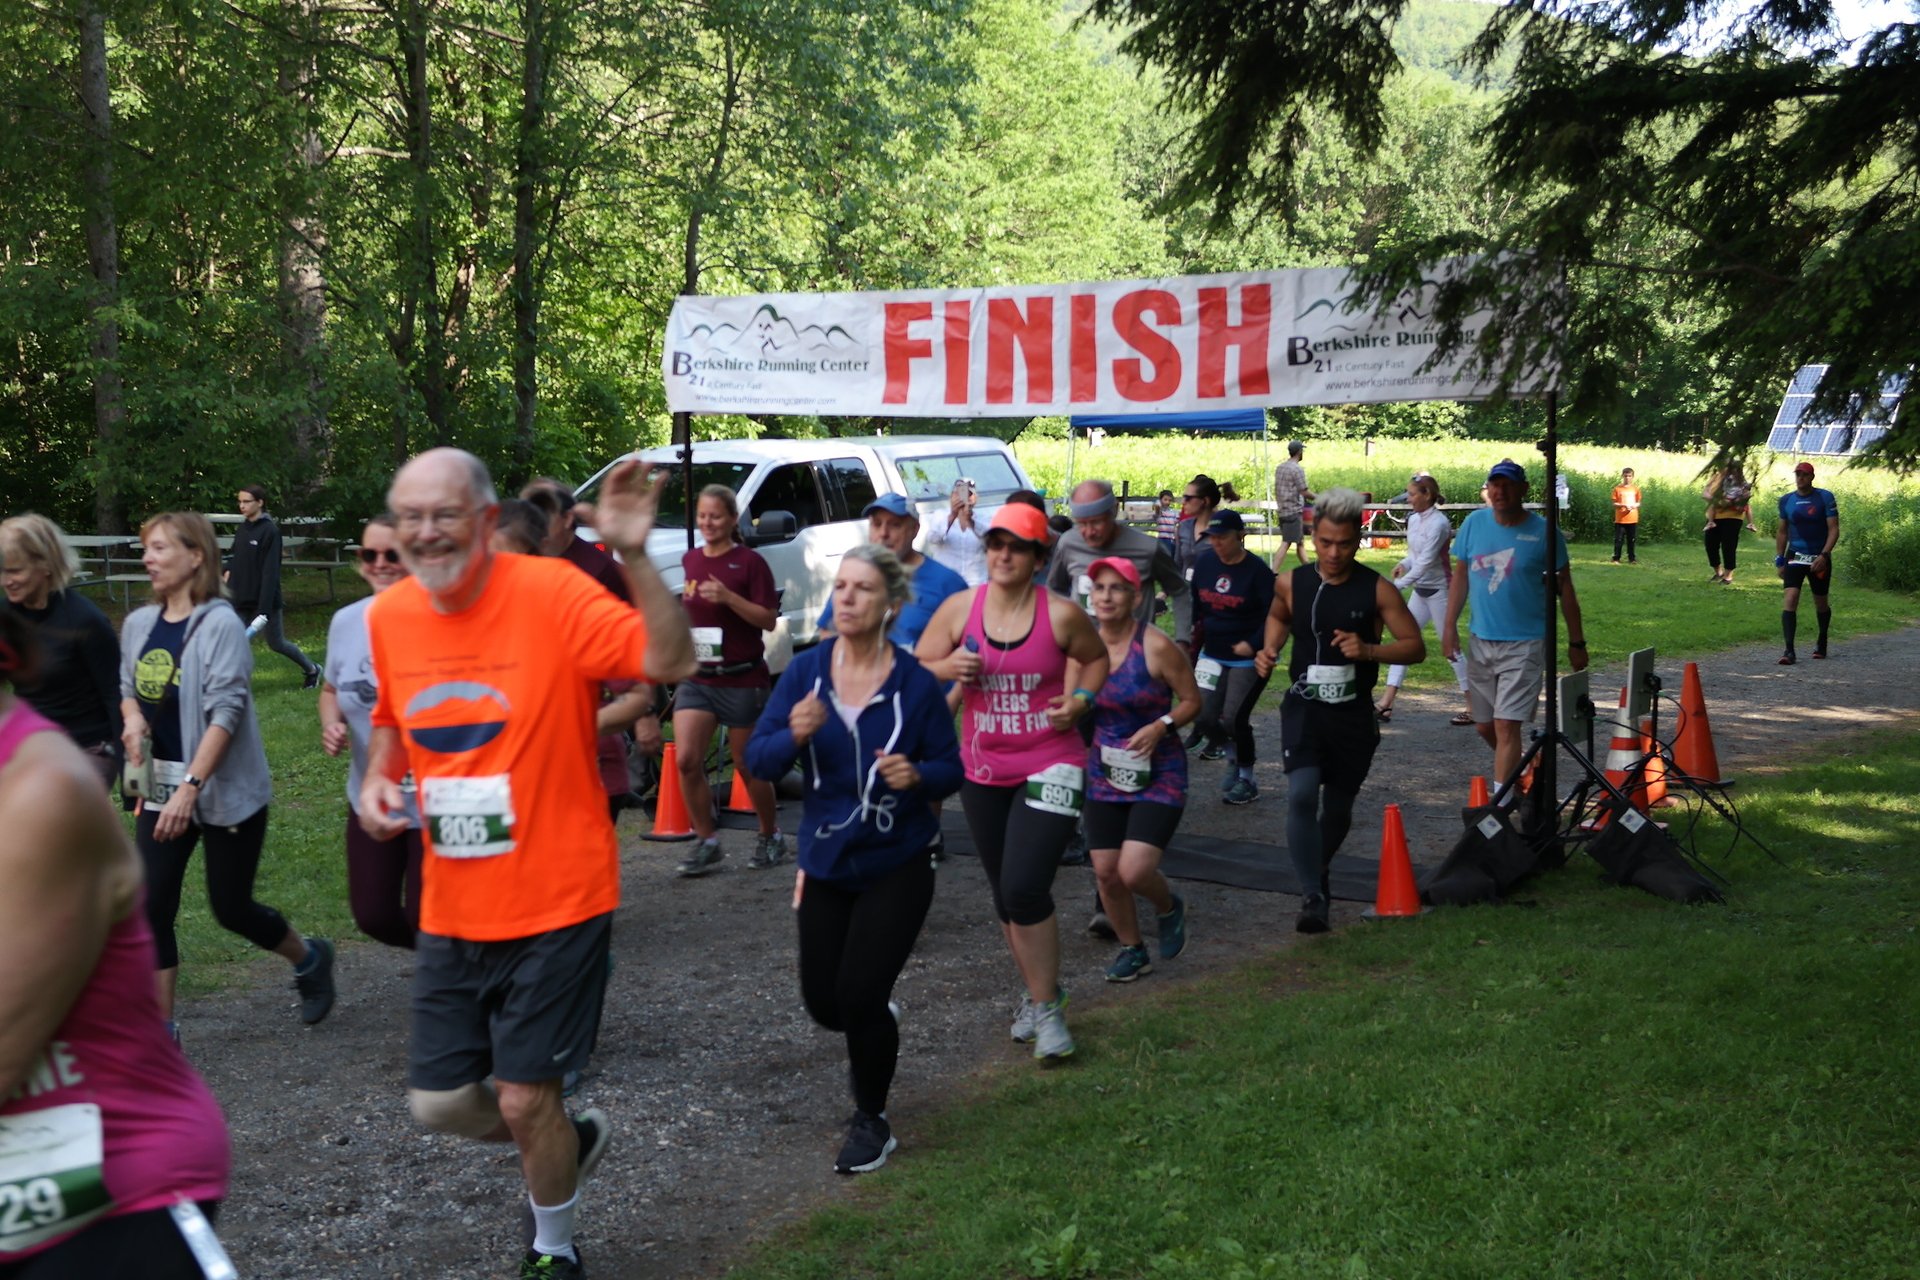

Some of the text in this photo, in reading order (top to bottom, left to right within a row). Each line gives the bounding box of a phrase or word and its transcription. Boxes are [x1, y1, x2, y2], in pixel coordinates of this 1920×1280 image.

[882, 283, 1271, 404] FINISH
[1287, 328, 1475, 366] Berkshire Runng
[672, 351, 869, 376] Berkshire Running Center
[1345, 361, 1384, 372] Century
[1385, 359, 1405, 369] Fast
[978, 673, 1042, 692] SHUT UP
[1318, 684, 1346, 698] 687
[993, 693, 1029, 713] LEGS
[973, 709, 1050, 735] YOU'RE FIN
[1040, 783, 1073, 807] 690
[439, 815, 489, 846] 806
